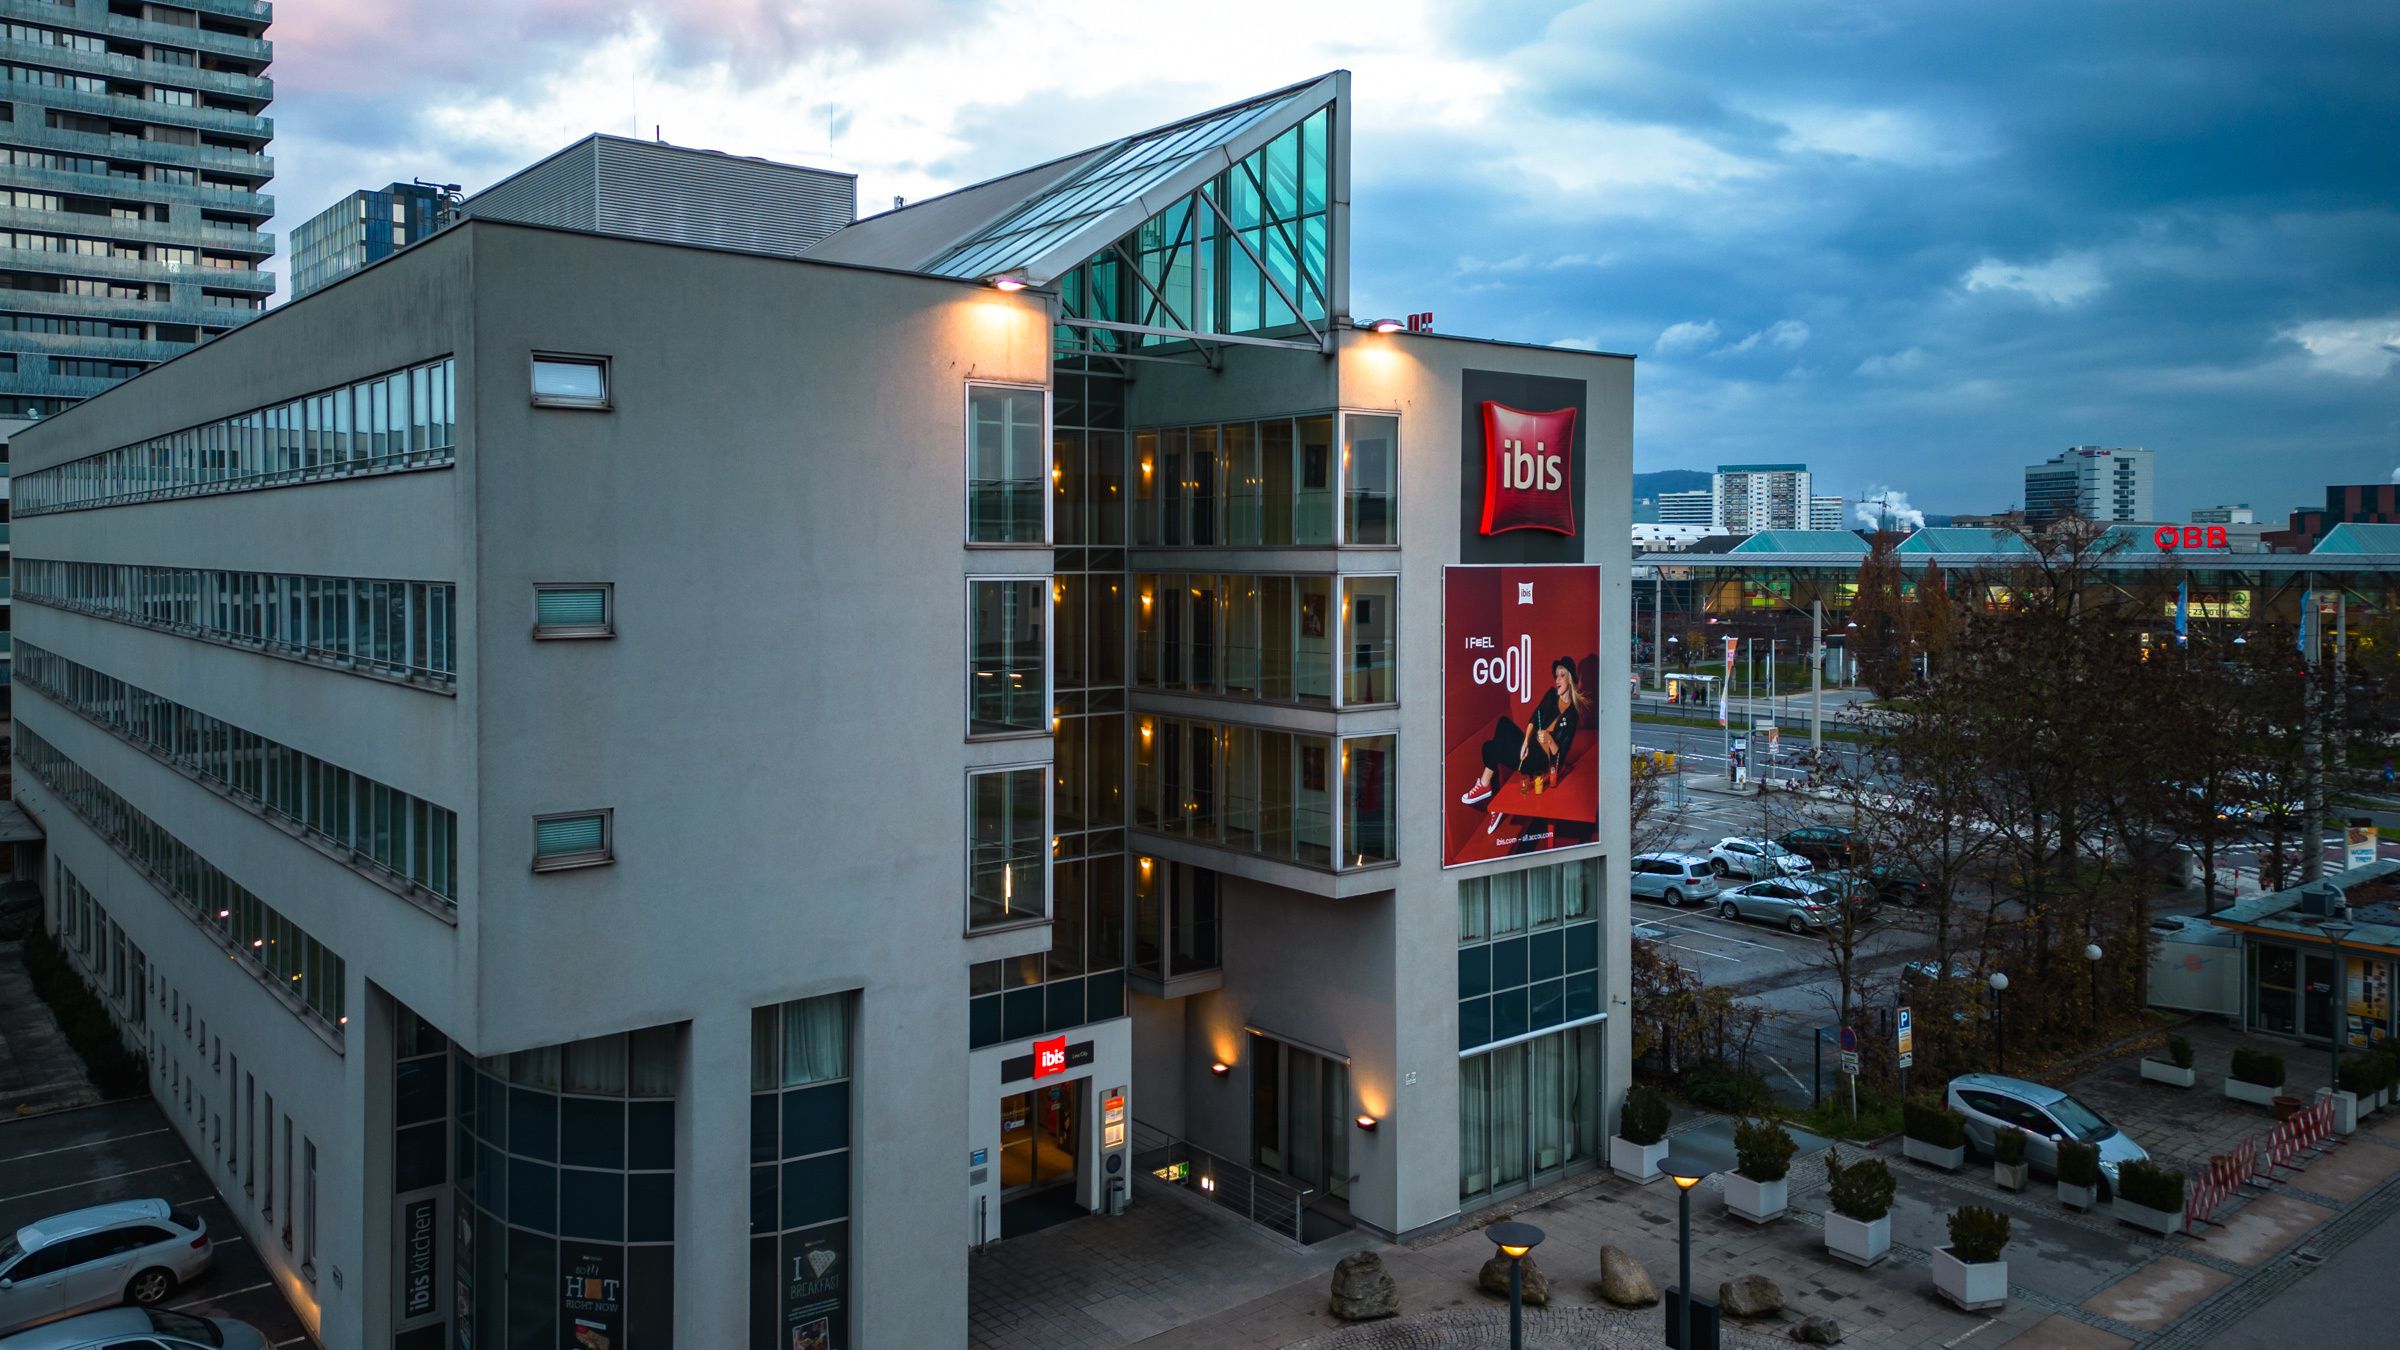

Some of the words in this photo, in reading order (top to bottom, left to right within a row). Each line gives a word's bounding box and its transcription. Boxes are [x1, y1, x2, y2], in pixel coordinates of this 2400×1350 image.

[1503, 439, 1562, 491] ibis
[1520, 588, 1532, 598] ibis
[1465, 637, 1468, 649] I
[1470, 636, 1495, 649] FEEL
[1473, 634, 1532, 704] GOOD
[1496, 837, 1517, 846] ibis.com
[1900, 1011, 1908, 1027] P
[1042, 1049, 1065, 1067] ibis
[410, 1206, 431, 1274] kitchen
[410, 1274, 430, 1312] ibis
[790, 1274, 840, 1299] BREAKFAST
[566, 1300, 594, 1311] RIGHT
[595, 1302, 619, 1313] NOW
